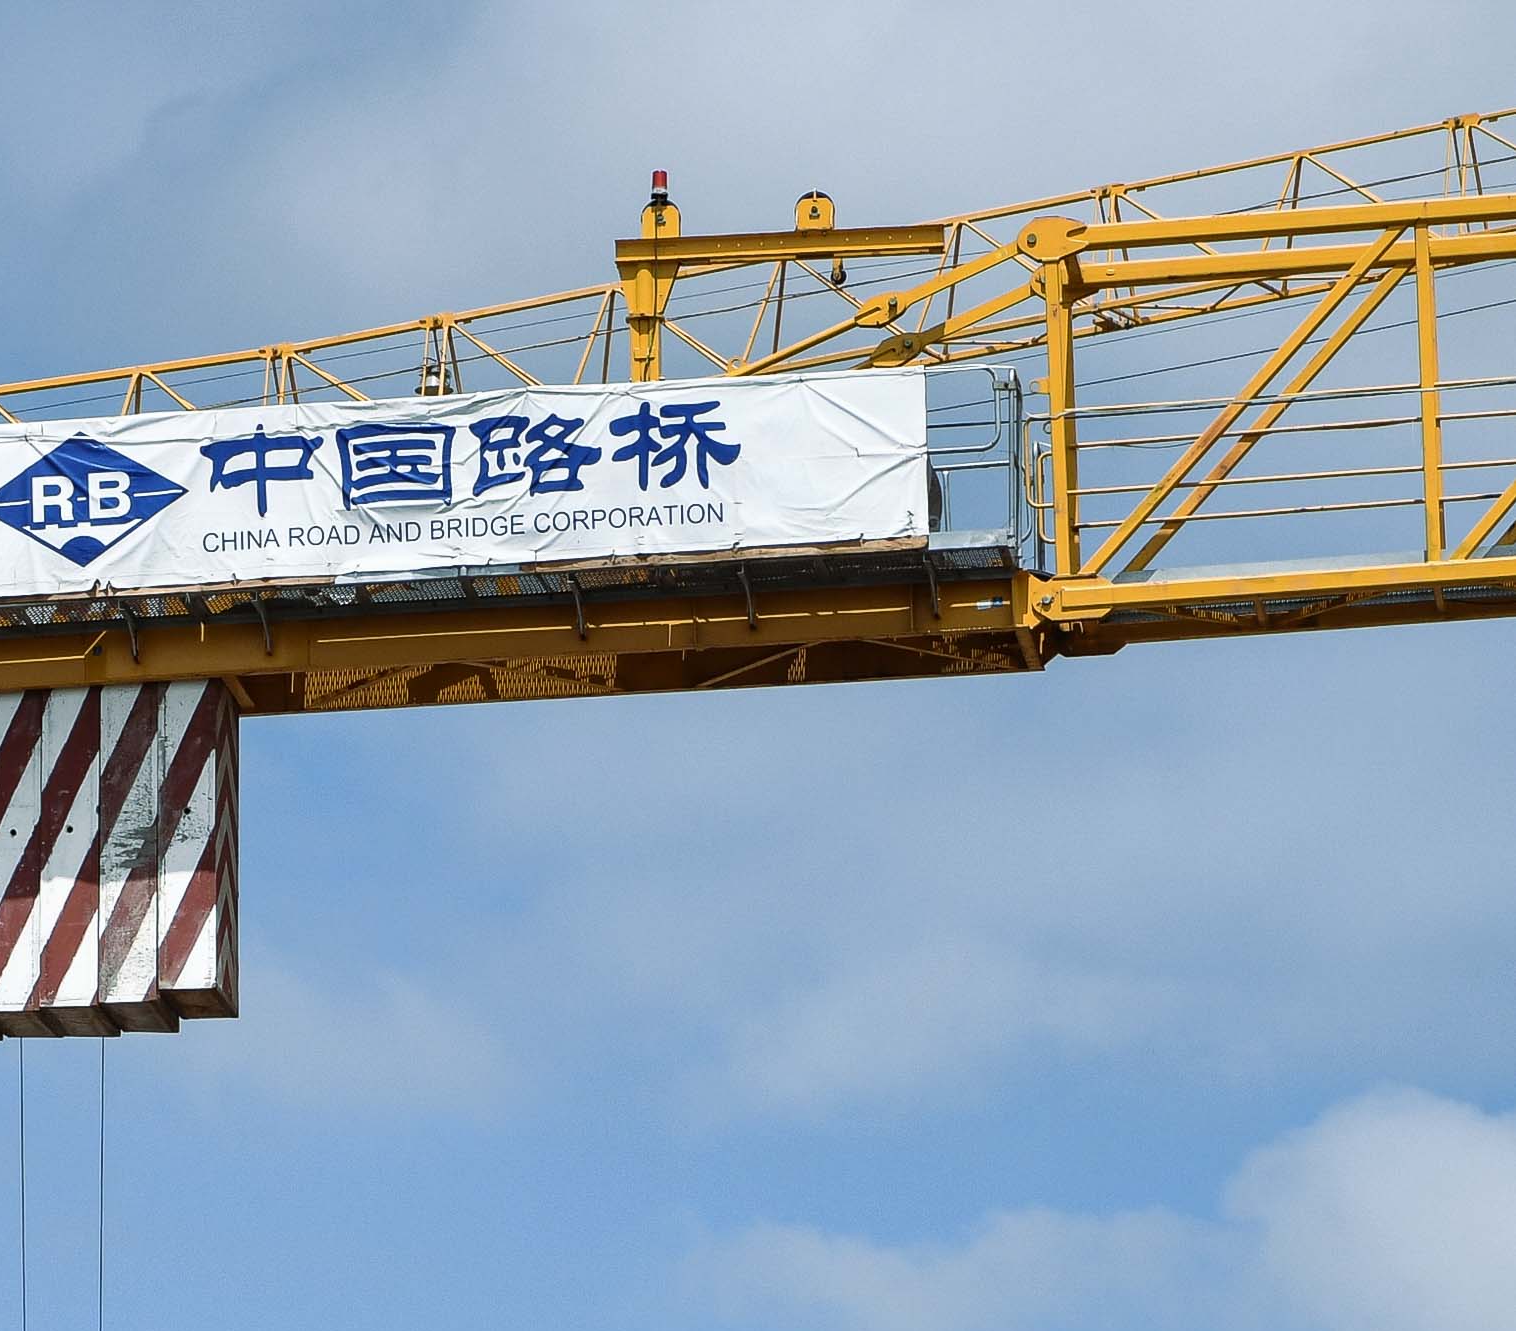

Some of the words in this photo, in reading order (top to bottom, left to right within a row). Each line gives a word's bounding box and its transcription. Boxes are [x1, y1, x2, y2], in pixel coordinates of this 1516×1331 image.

[199, 400, 742, 517] 中国路桥
[201, 528, 281, 553] CHINA
[288, 525, 361, 548] ROAD
[368, 521, 422, 545] AND
[430, 514, 525, 540] BRIDGE
[533, 502, 724, 534] CORPORATION
